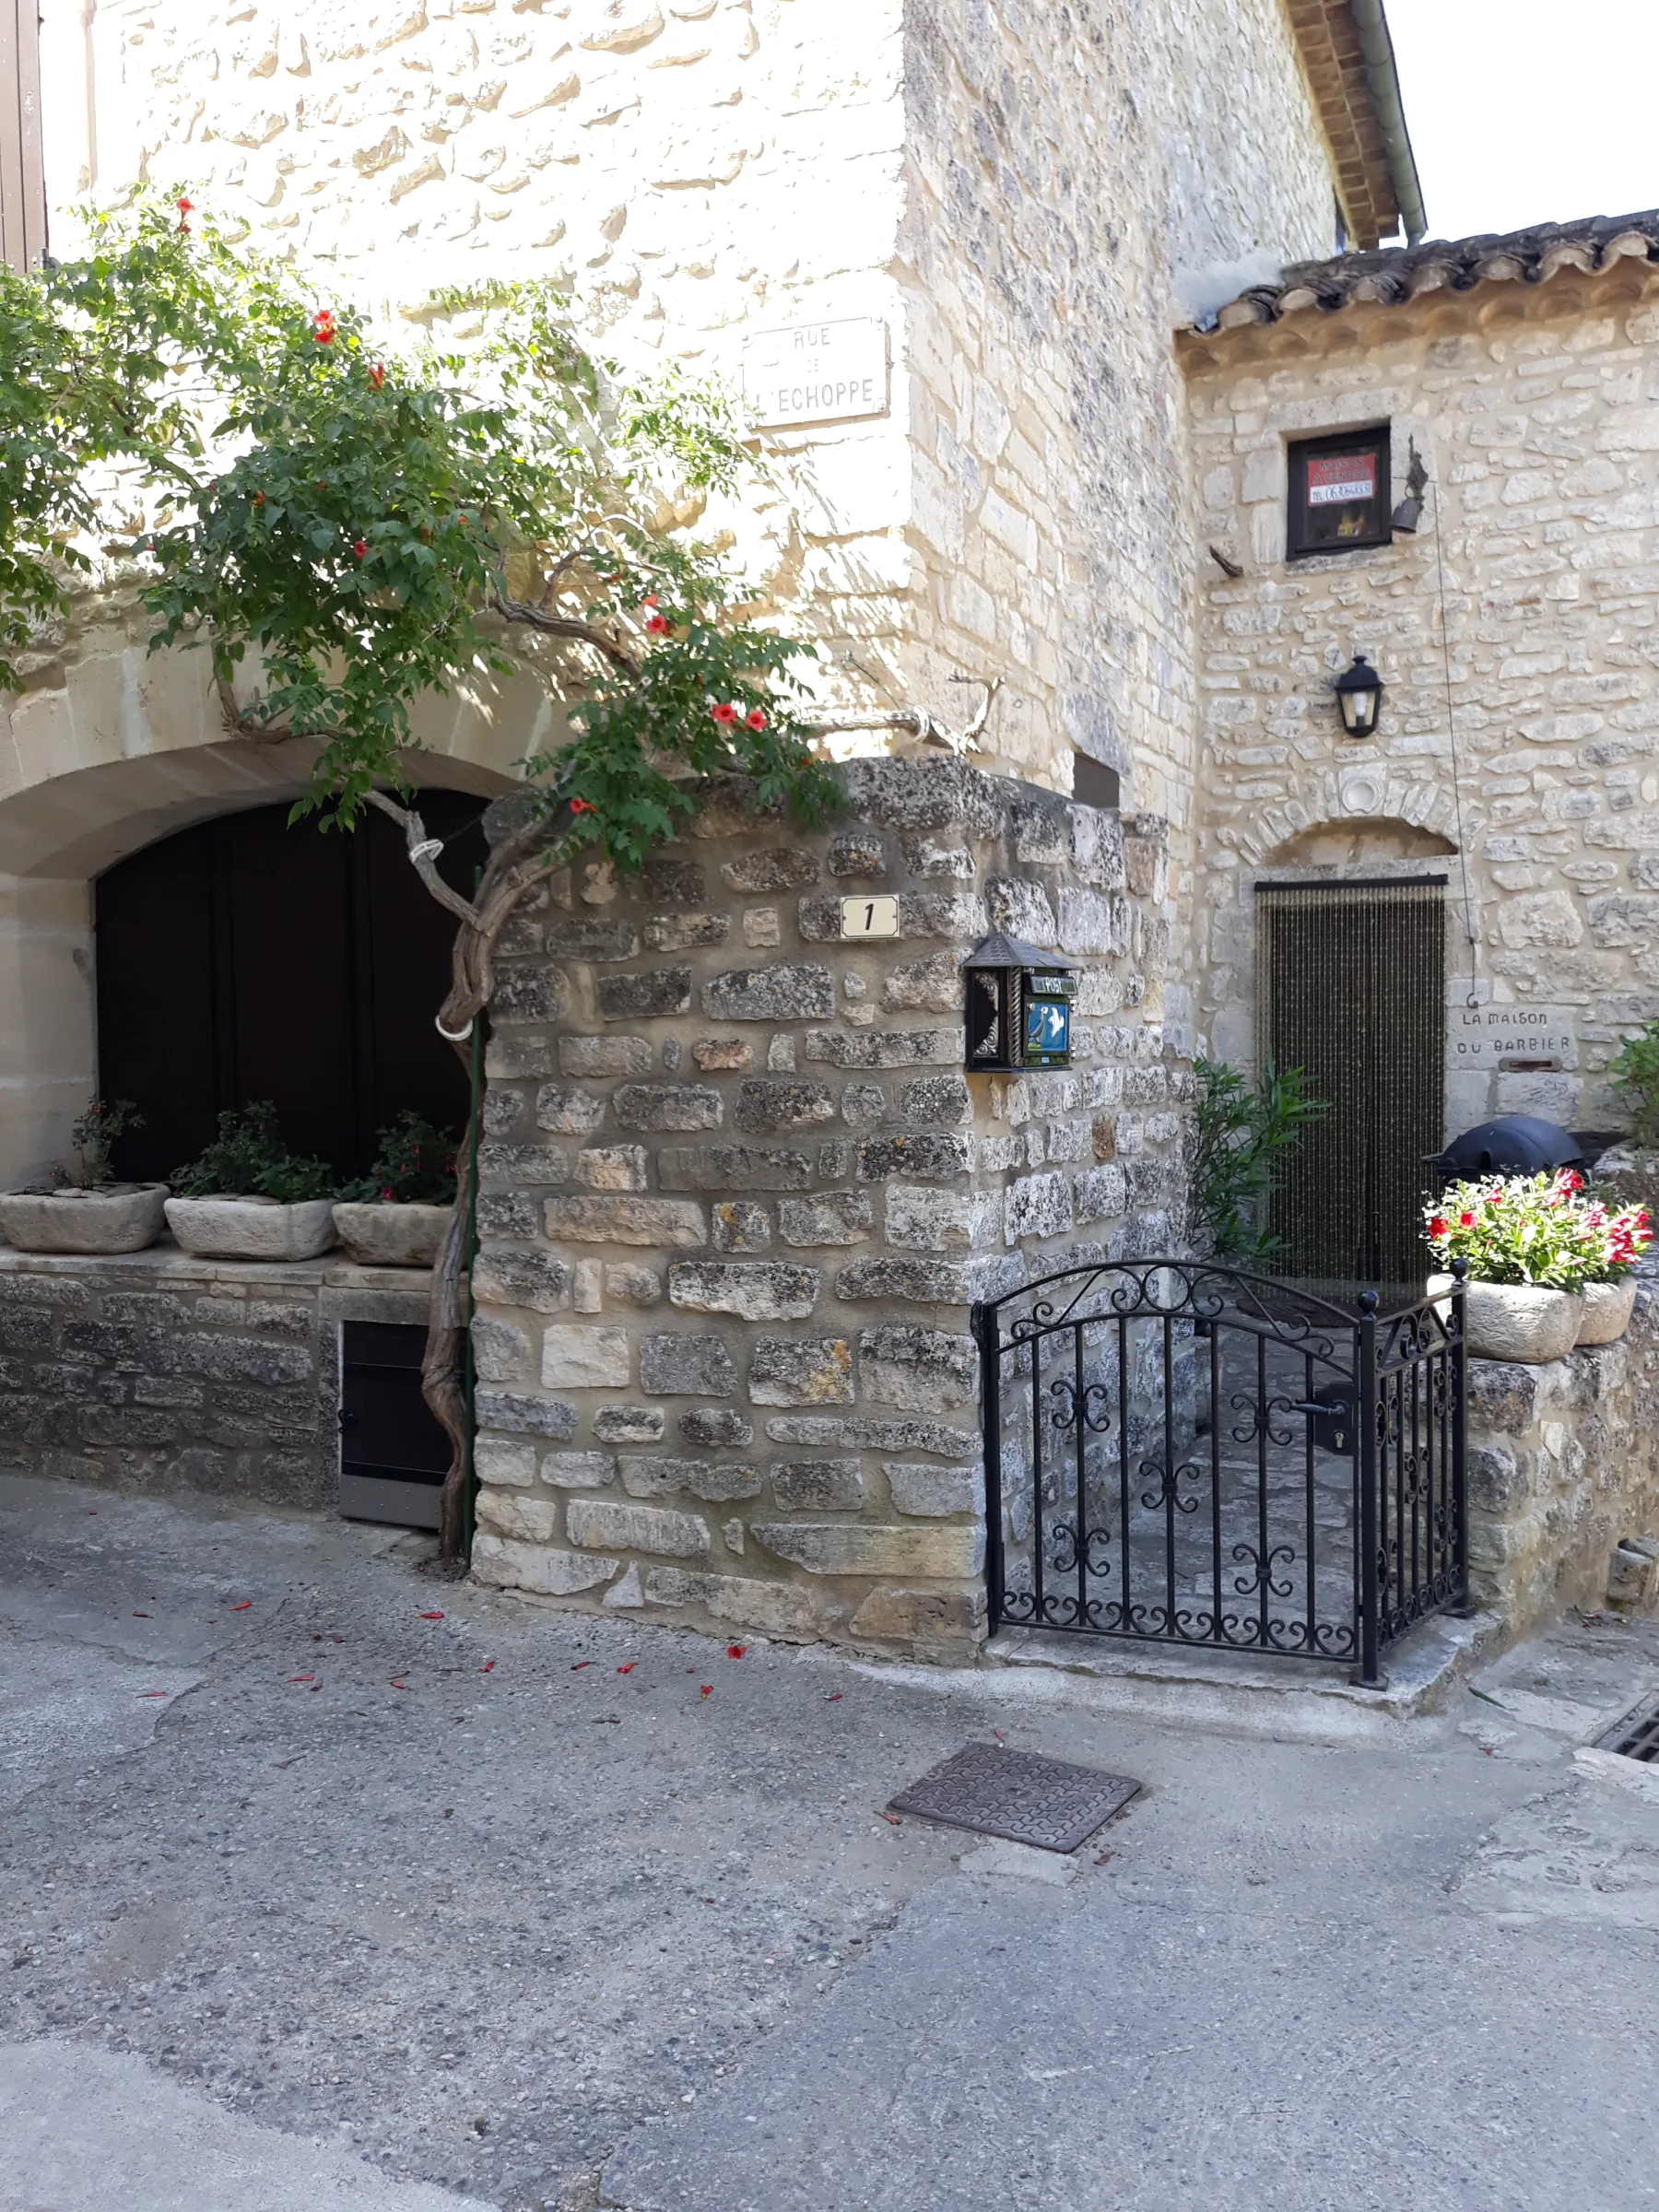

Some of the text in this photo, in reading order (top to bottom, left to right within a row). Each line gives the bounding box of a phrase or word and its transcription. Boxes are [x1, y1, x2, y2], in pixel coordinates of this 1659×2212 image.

[794, 328, 830, 348] RUE
[1321, 457, 1363, 471] MAISON
[865, 903, 875, 931] 1
[1463, 1012, 1547, 1025] LA MAISON
[1494, 1036, 1570, 1053] BARBIER
